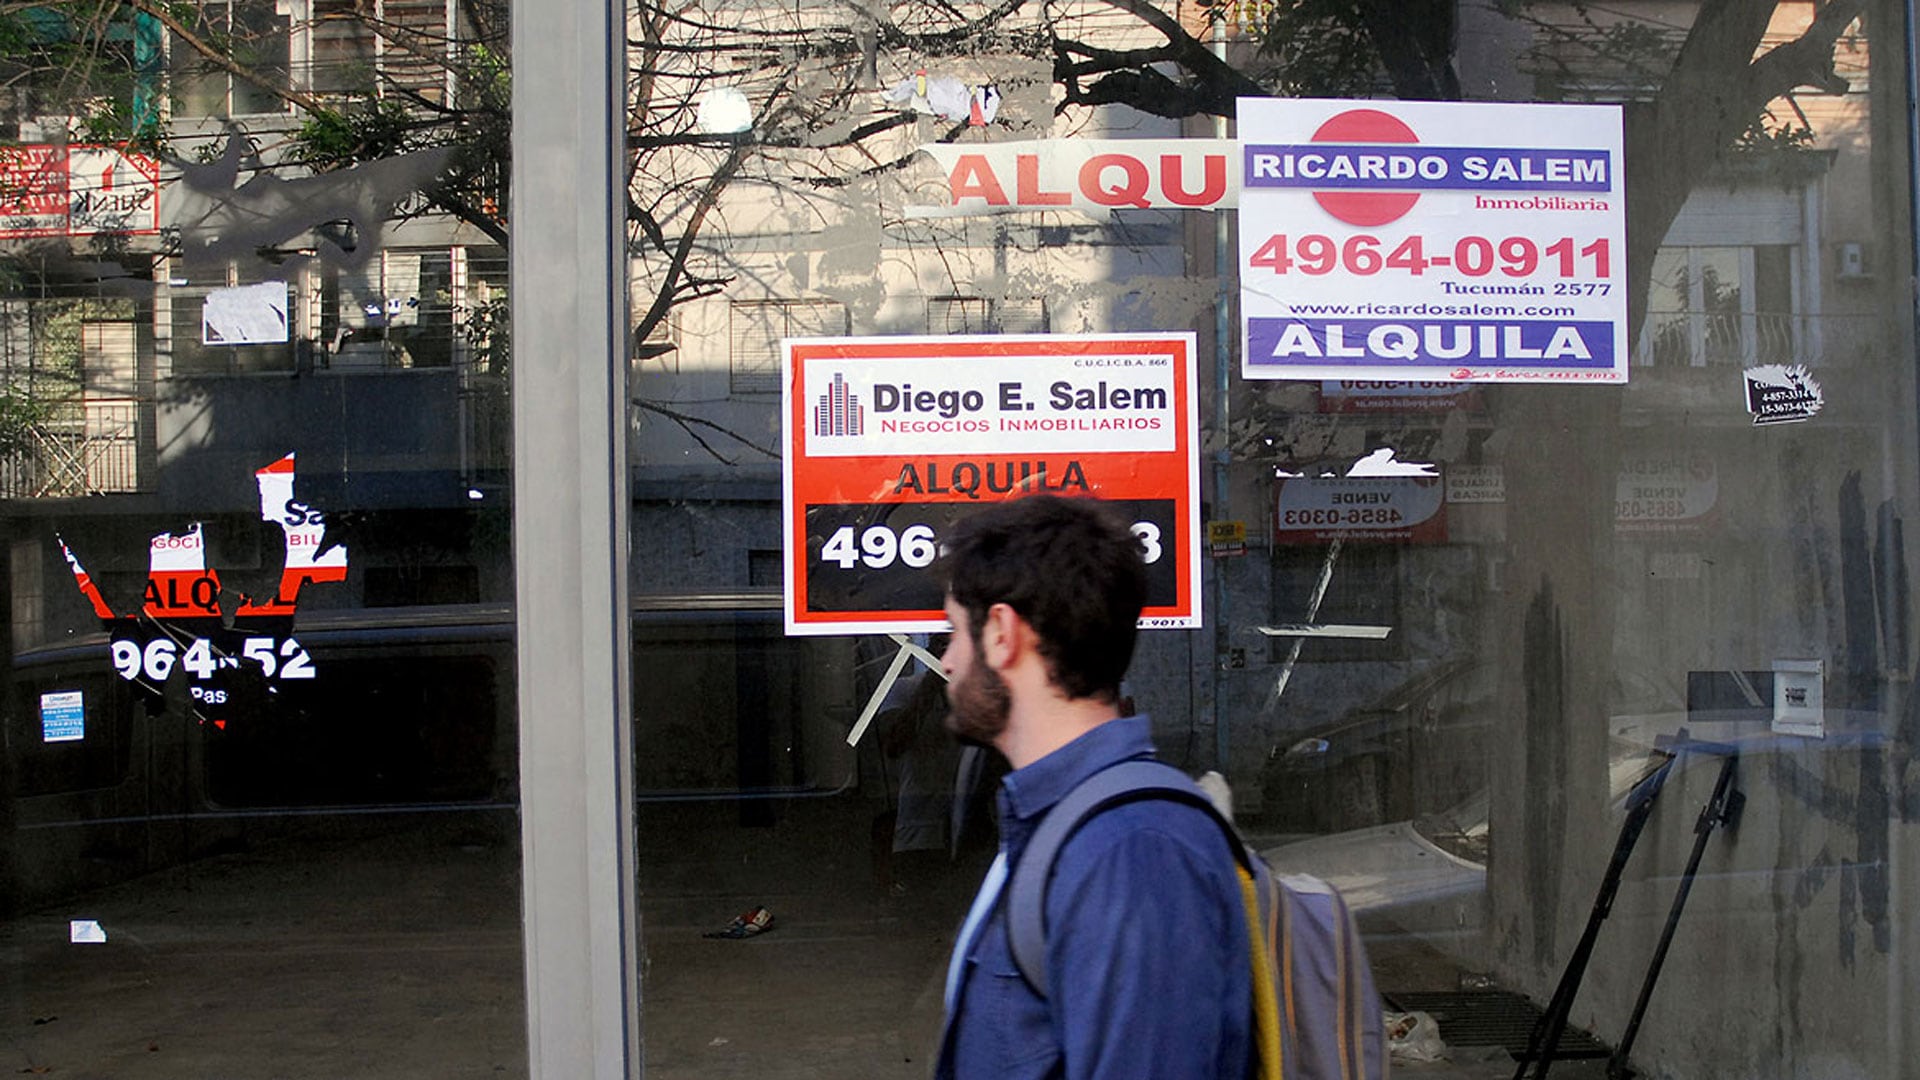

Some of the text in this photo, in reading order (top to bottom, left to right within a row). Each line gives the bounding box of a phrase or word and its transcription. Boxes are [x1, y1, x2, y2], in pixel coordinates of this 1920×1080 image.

[950, 153, 1227, 208] ALQU
[1252, 153, 1606, 184] RICARDO SALEM
[1474, 194, 1610, 212] Inmobiliaria
[1249, 233, 1611, 279] 4964-0911
[1440, 280, 1612, 297] Tucumán 2577
[1289, 301, 1576, 318] www.ricardosalem.com
[1271, 324, 1593, 362] ALQUILA
[873, 381, 1168, 419] Diego E. Salem
[881, 416, 1162, 434] NEGOCIOS INMOBILIARIOS
[893, 459, 1090, 499] ALQUILA
[821, 524, 949, 570] 496
